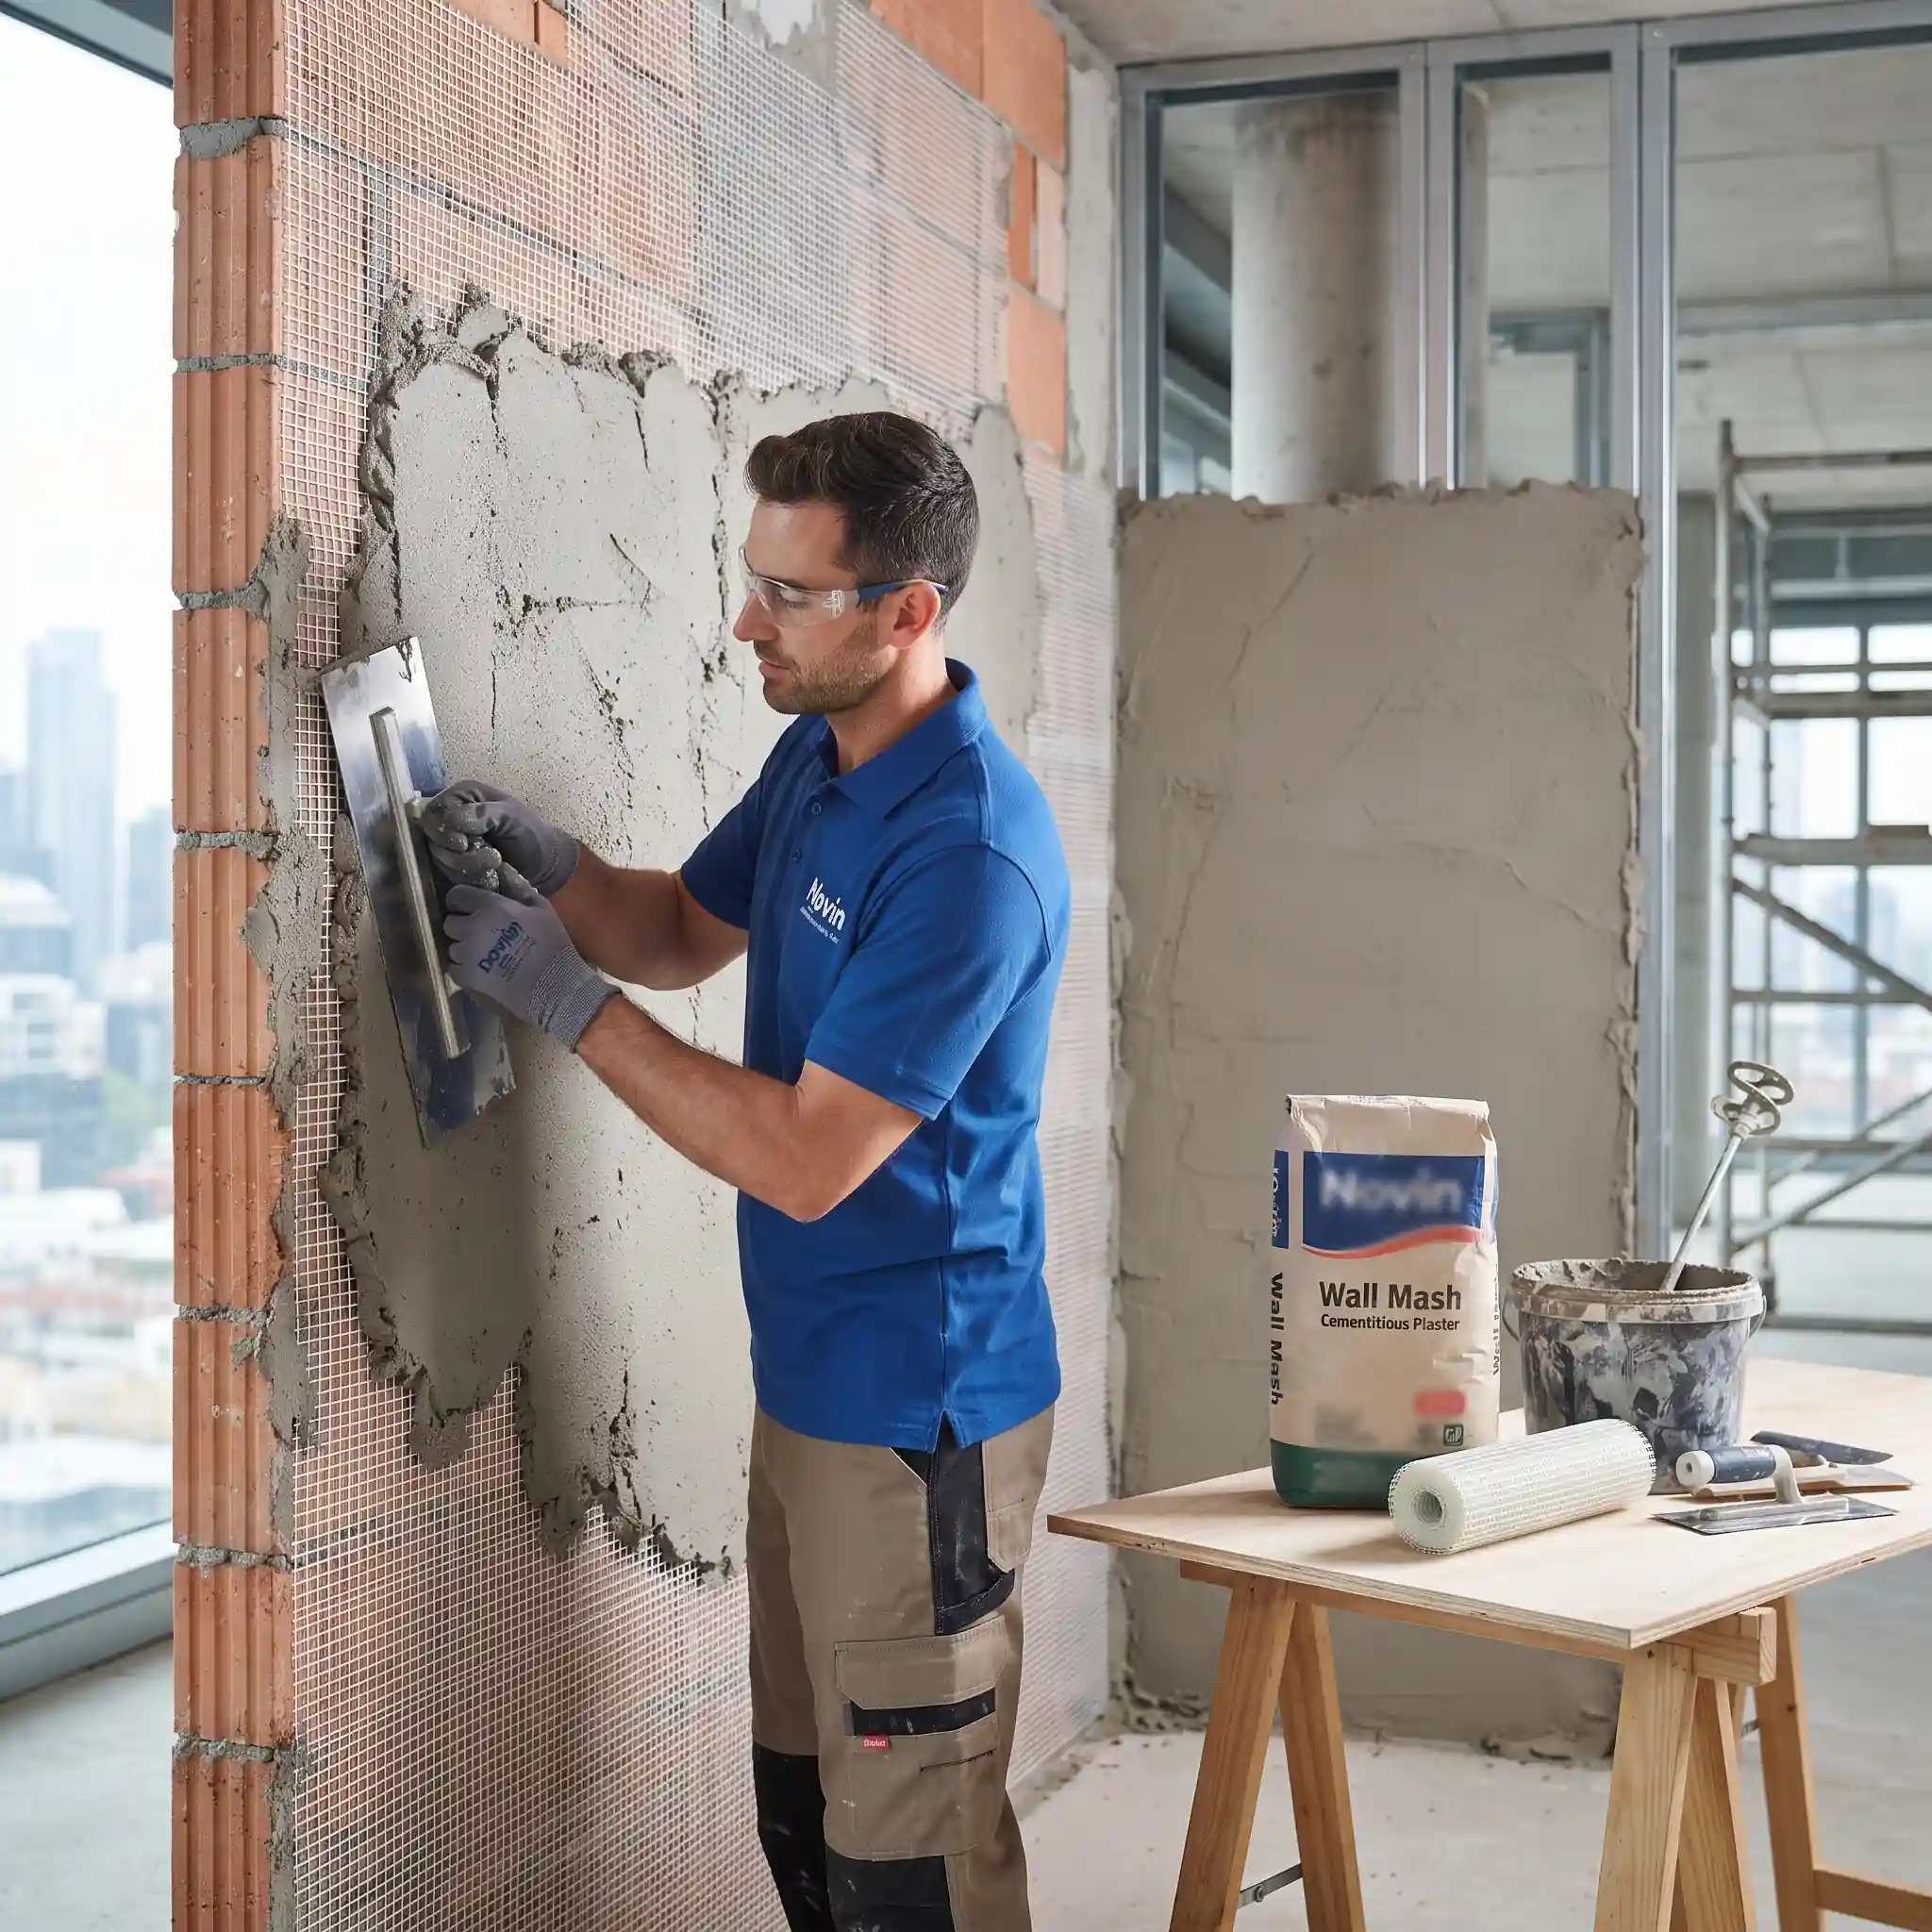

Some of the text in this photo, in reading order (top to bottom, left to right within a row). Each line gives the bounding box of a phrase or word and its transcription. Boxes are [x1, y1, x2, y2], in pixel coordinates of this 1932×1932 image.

[806, 876, 845, 930] Novin
[1319, 1281, 1461, 1310] Wall Mash
[1271, 1273, 1284, 1405] Wall Mash
[1321, 1313, 1460, 1331] Cementitious Plaster
